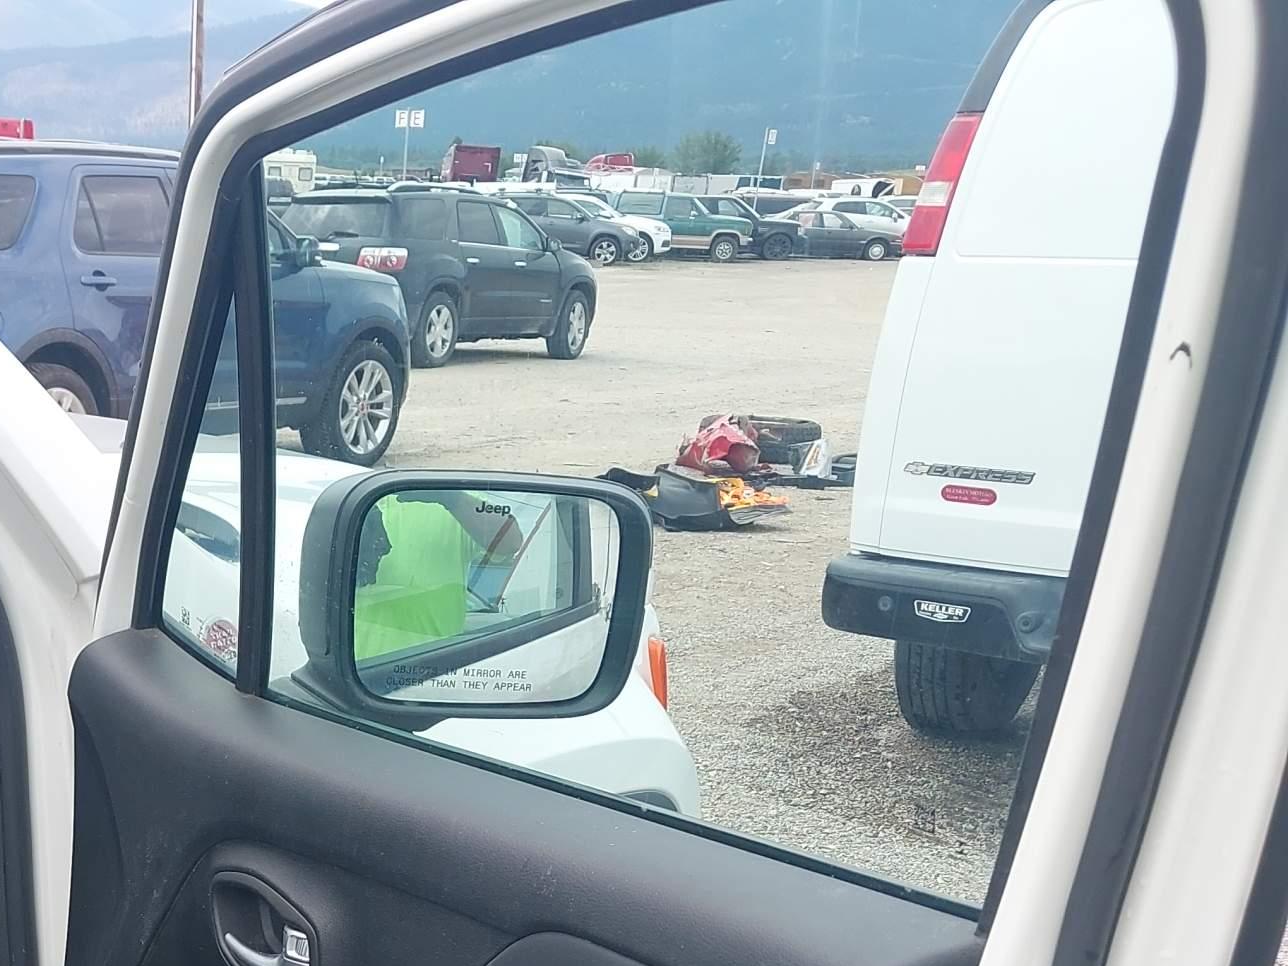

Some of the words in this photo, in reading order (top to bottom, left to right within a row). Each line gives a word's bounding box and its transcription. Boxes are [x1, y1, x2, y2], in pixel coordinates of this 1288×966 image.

[398, 112, 407, 126] F
[413, 111, 422, 126] E
[928, 463, 1035, 484] EXPRESS
[475, 501, 511, 517] Jeep
[920, 602, 964, 617] KELLER
[393, 664, 439, 675] OBJECTS
[446, 667, 457, 676] IN
[463, 668, 502, 678] MIRROR
[507, 670, 528, 680] ARE
[386, 677, 424, 687] CLOSER
[431, 679, 456, 689] THAN
[463, 681, 488, 690] THEY
[493, 681, 533, 692] APPEAR
